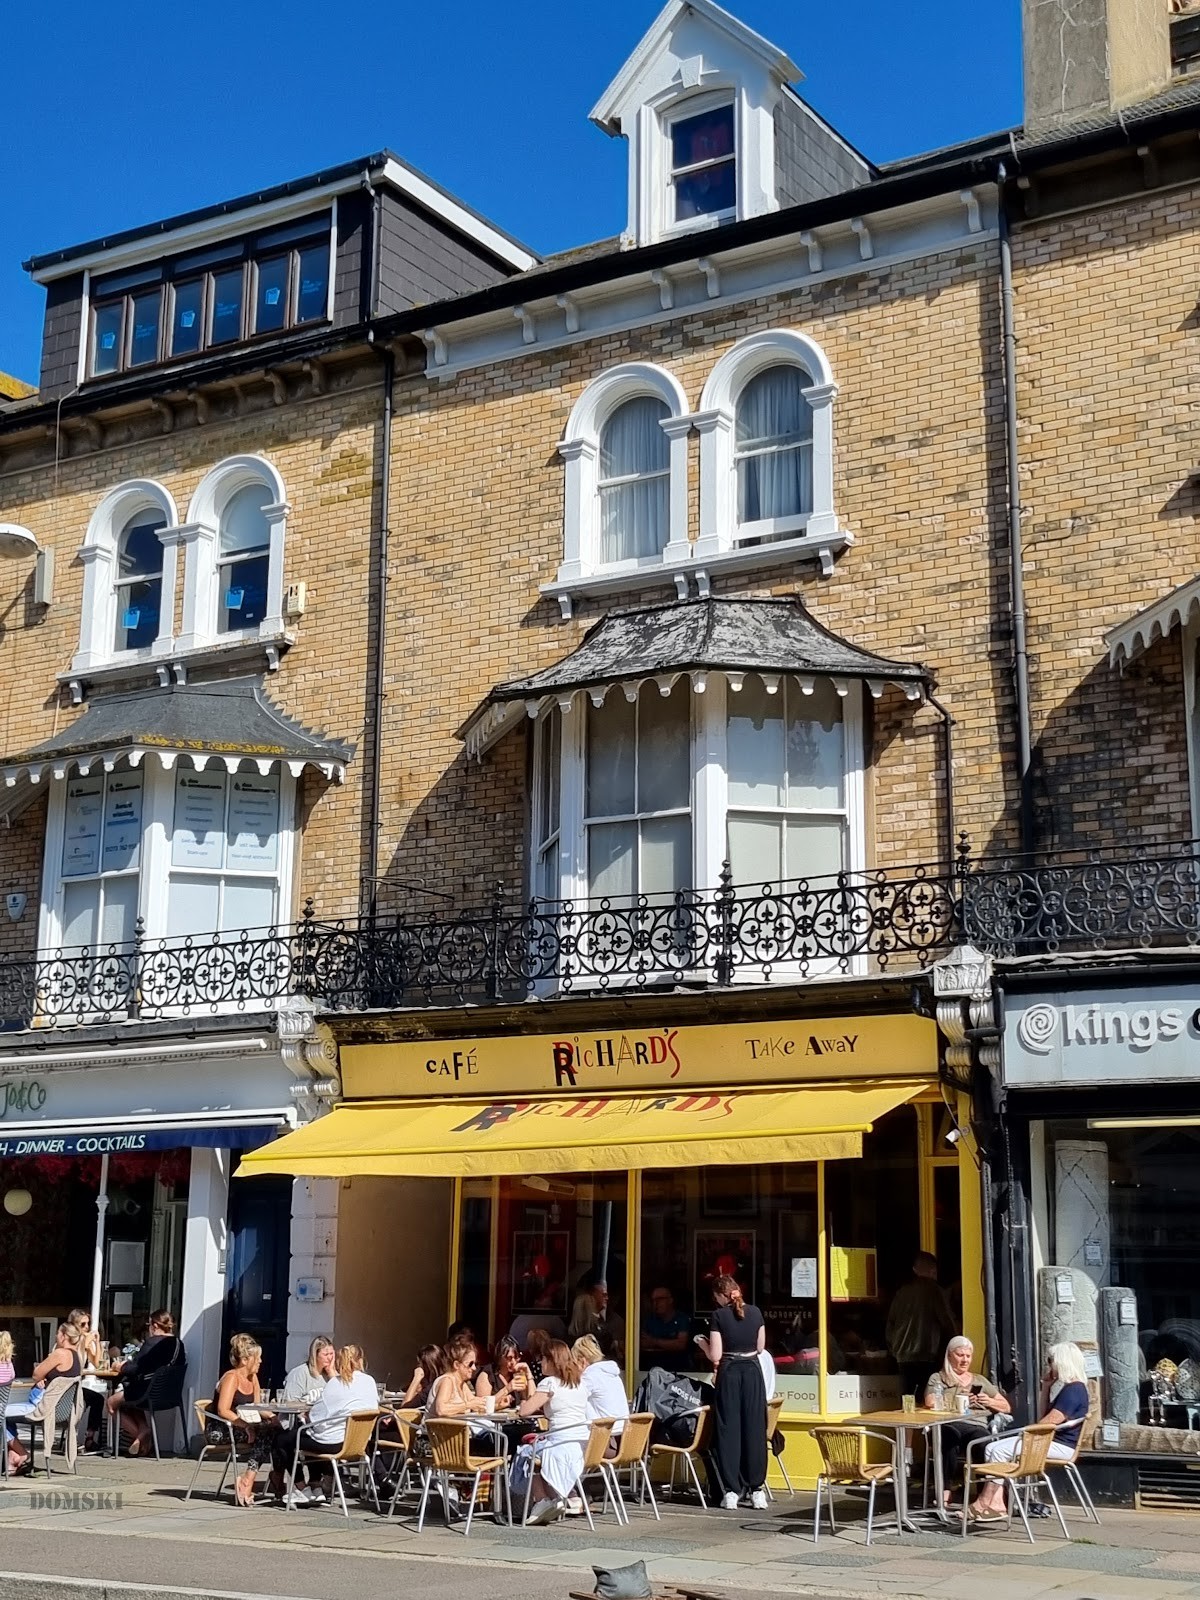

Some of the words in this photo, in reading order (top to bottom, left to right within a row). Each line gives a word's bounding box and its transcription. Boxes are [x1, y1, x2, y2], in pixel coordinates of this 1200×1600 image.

[1065, 1004, 1185, 1047] kings
[15, 1139, 65, 1154] DINNER
[76, 1134, 146, 1152] COCKTAILS
[671, 1385, 690, 1401] MOSS
[772, 1391, 785, 1399] OT
[787, 1390, 816, 1400] FOOD
[839, 1390, 854, 1399] EAT
